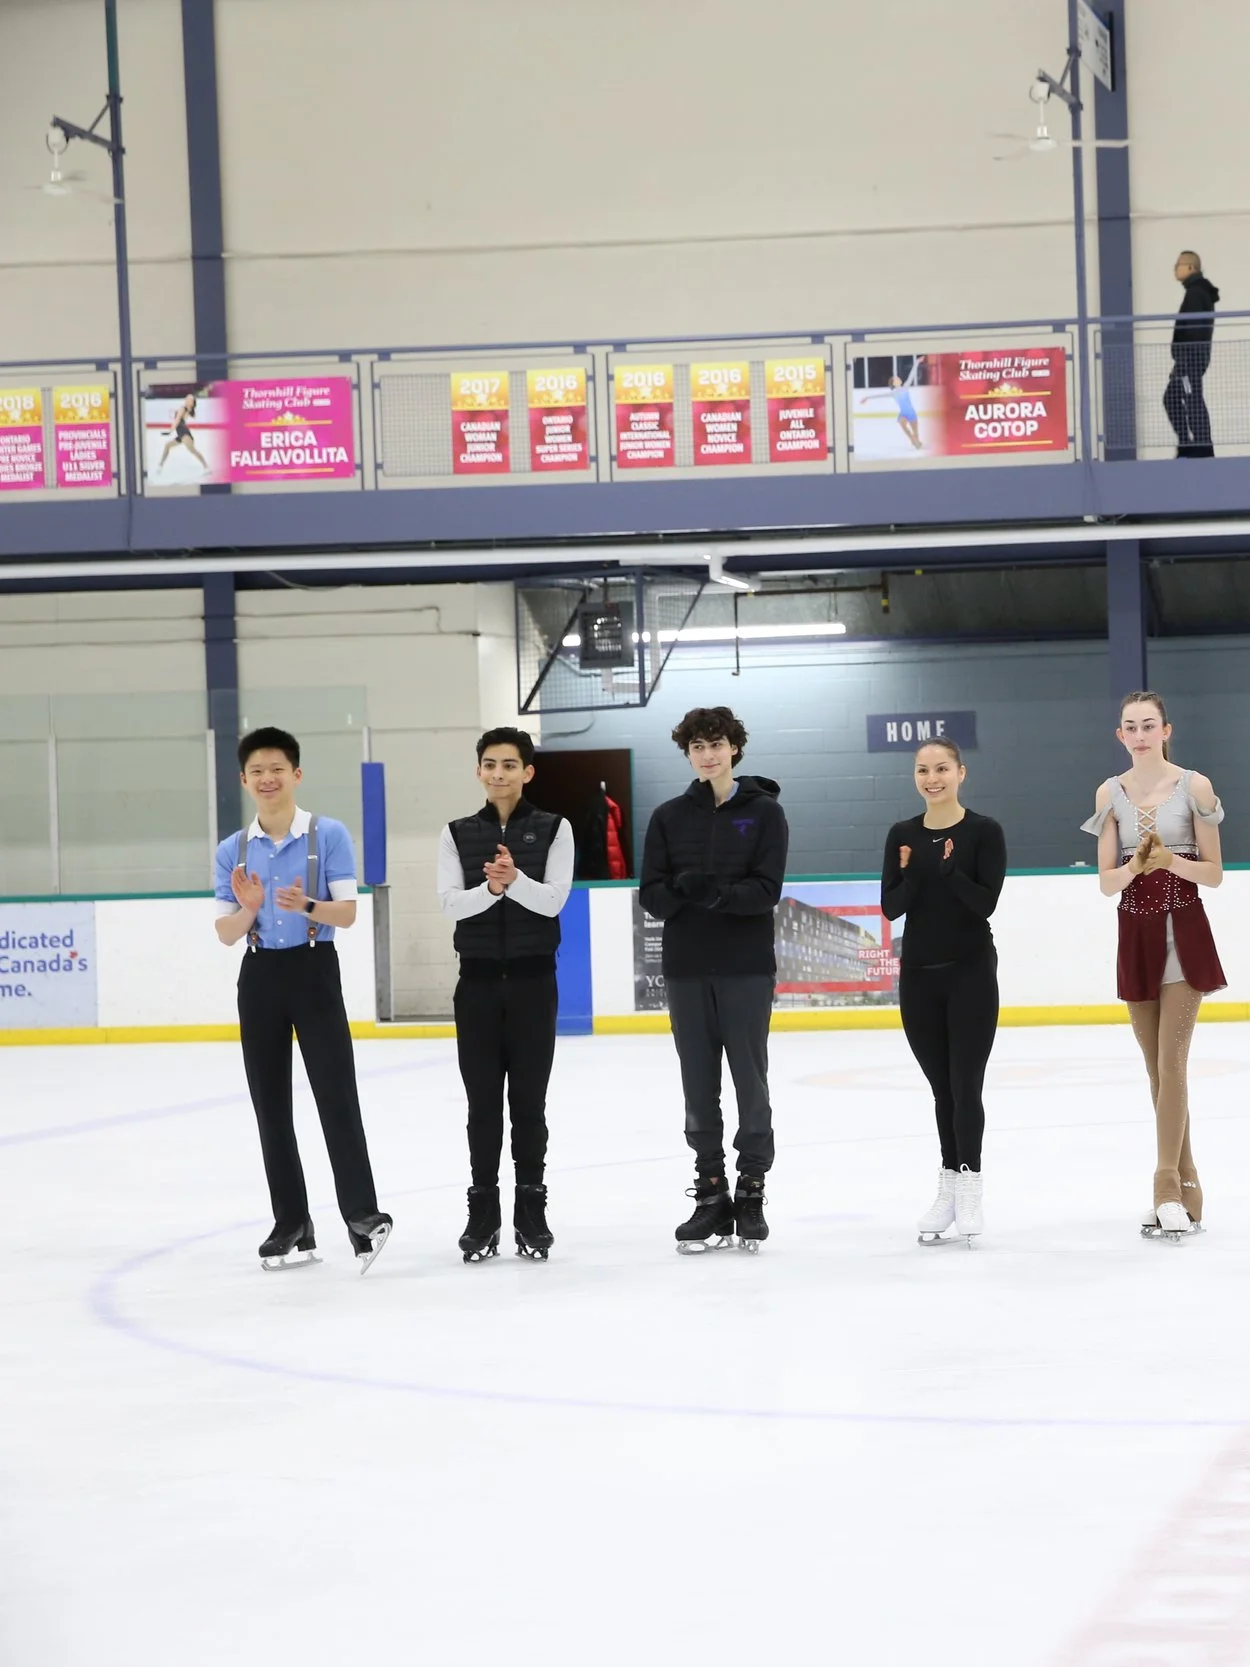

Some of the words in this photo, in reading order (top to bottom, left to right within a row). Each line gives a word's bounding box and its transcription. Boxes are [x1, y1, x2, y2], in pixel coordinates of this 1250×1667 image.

[959, 357, 1012, 370] Thornhill
[1014, 357, 1050, 368] Figure
[622, 371, 666, 388] 2016
[698, 369, 741, 385] 2016
[774, 364, 817, 382] 2015
[959, 369, 1000, 382] Skating
[1002, 367, 1029, 379] Club
[460, 378, 501, 395] 2017
[535, 374, 578, 391] 2016
[243, 386, 294, 398] Thornhill
[295, 385, 330, 398] Figure
[0, 395, 34, 412] 018
[242, 398, 282, 410] Skating
[284, 396, 311, 408] Club
[701, 412, 742, 423] CANADIAN
[779, 408, 815, 421] JUVENILE
[965, 401, 1047, 421] AURORA
[460, 421, 501, 432] CANADIAN
[705, 422, 738, 433] WOMEN
[790, 419, 805, 429] ALL
[974, 420, 1039, 438] COTOP
[260, 430, 317, 448] ERICA
[464, 431, 497, 442] WOMAN
[707, 433, 737, 443] NOVICE
[780, 428, 816, 440] ONTARIO
[700, 443, 744, 454] CHAMPION
[776, 439, 820, 451] CHAMPION
[230, 447, 349, 467] FALLAVOLLITA
[460, 452, 503, 463] CHAMPION
[540, 452, 578, 463] CHAMPION
[626, 449, 664, 459] CHAMPION
[65, 471, 104, 482] MEDALIST
[0, 928, 74, 950] dicated
[858, 950, 890, 959] RIGHT
[880, 958, 900, 967] THE
